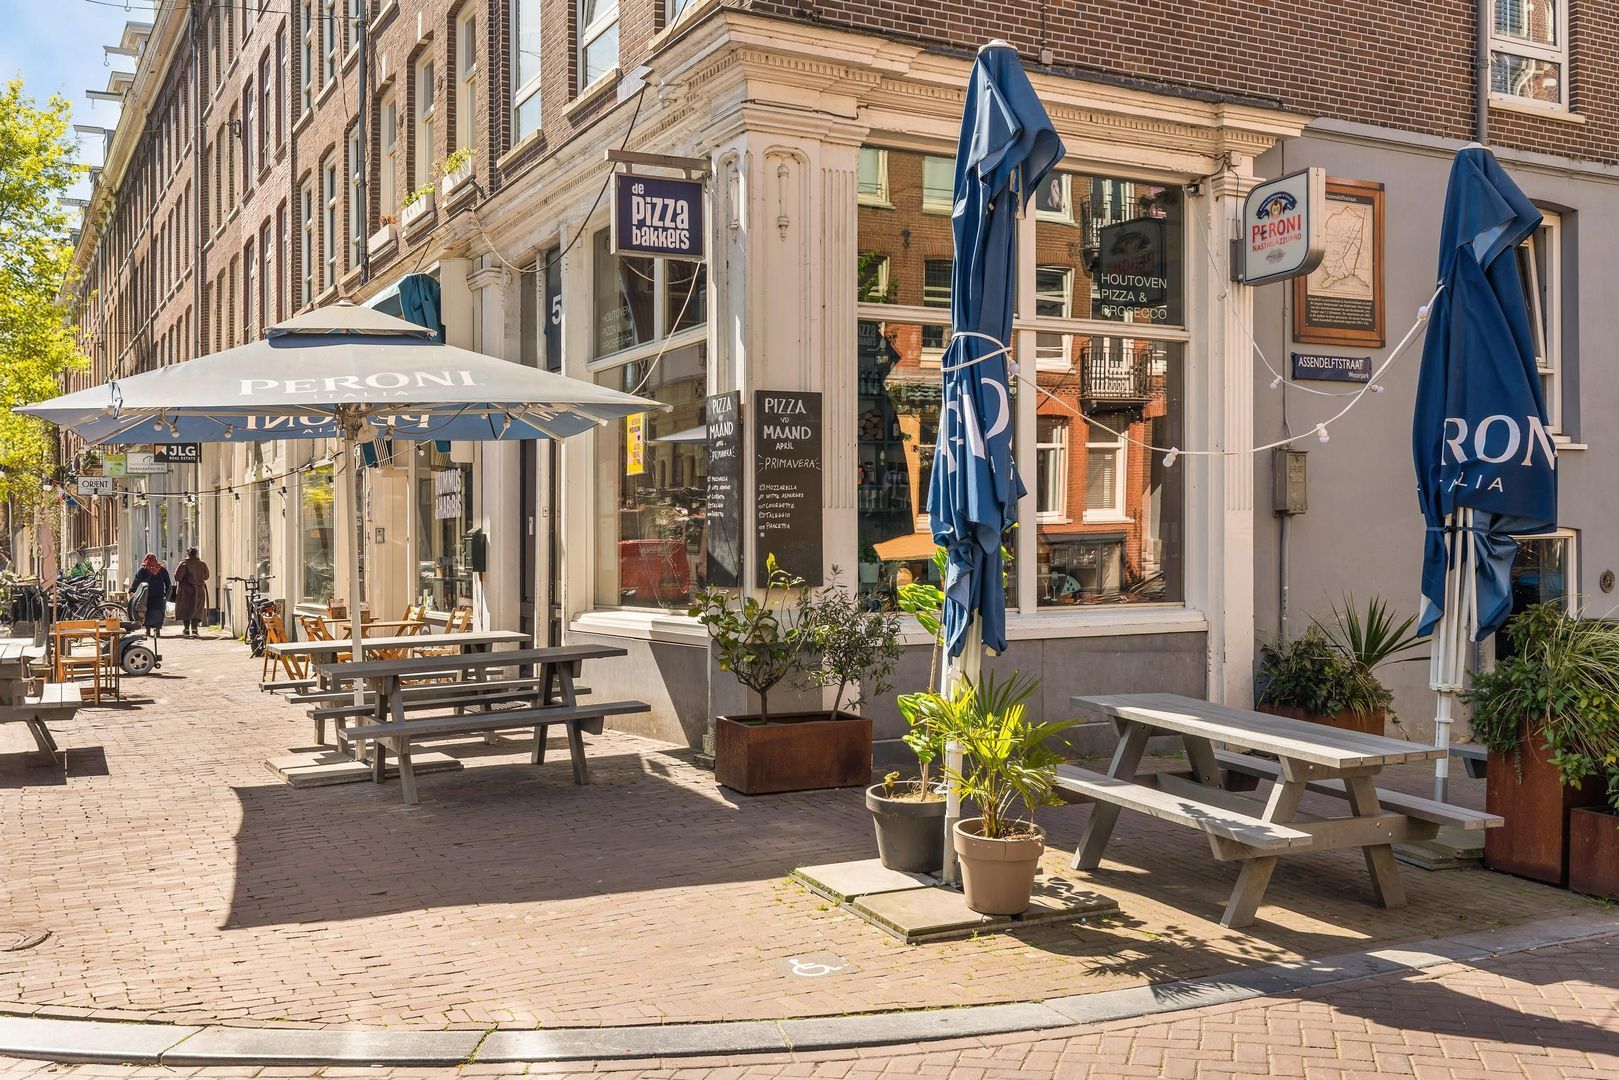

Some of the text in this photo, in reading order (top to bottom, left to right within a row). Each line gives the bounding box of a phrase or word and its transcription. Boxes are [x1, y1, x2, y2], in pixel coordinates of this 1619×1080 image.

[631, 183, 645, 195] de
[1252, 215, 1302, 243] PERONI
[632, 226, 690, 250] bakkers
[1101, 273, 1167, 289] HOUTOVEN
[1101, 288, 1147, 303] PIZZA &
[1101, 304, 1167, 320] PROSECCO
[1298, 356, 1364, 370] ASSENDELFTSTRAAT
[238, 370, 477, 396] PERONI
[313, 390, 409, 399] ITALIA
[712, 396, 732, 414] PIZZA
[764, 397, 807, 414] PIZZA
[709, 421, 734, 440] MAAND
[763, 425, 812, 440] MAAND
[169, 445, 196, 456] JLG
[764, 457, 815, 470] PRIMAVERA
[82, 480, 109, 488] ORIENT
